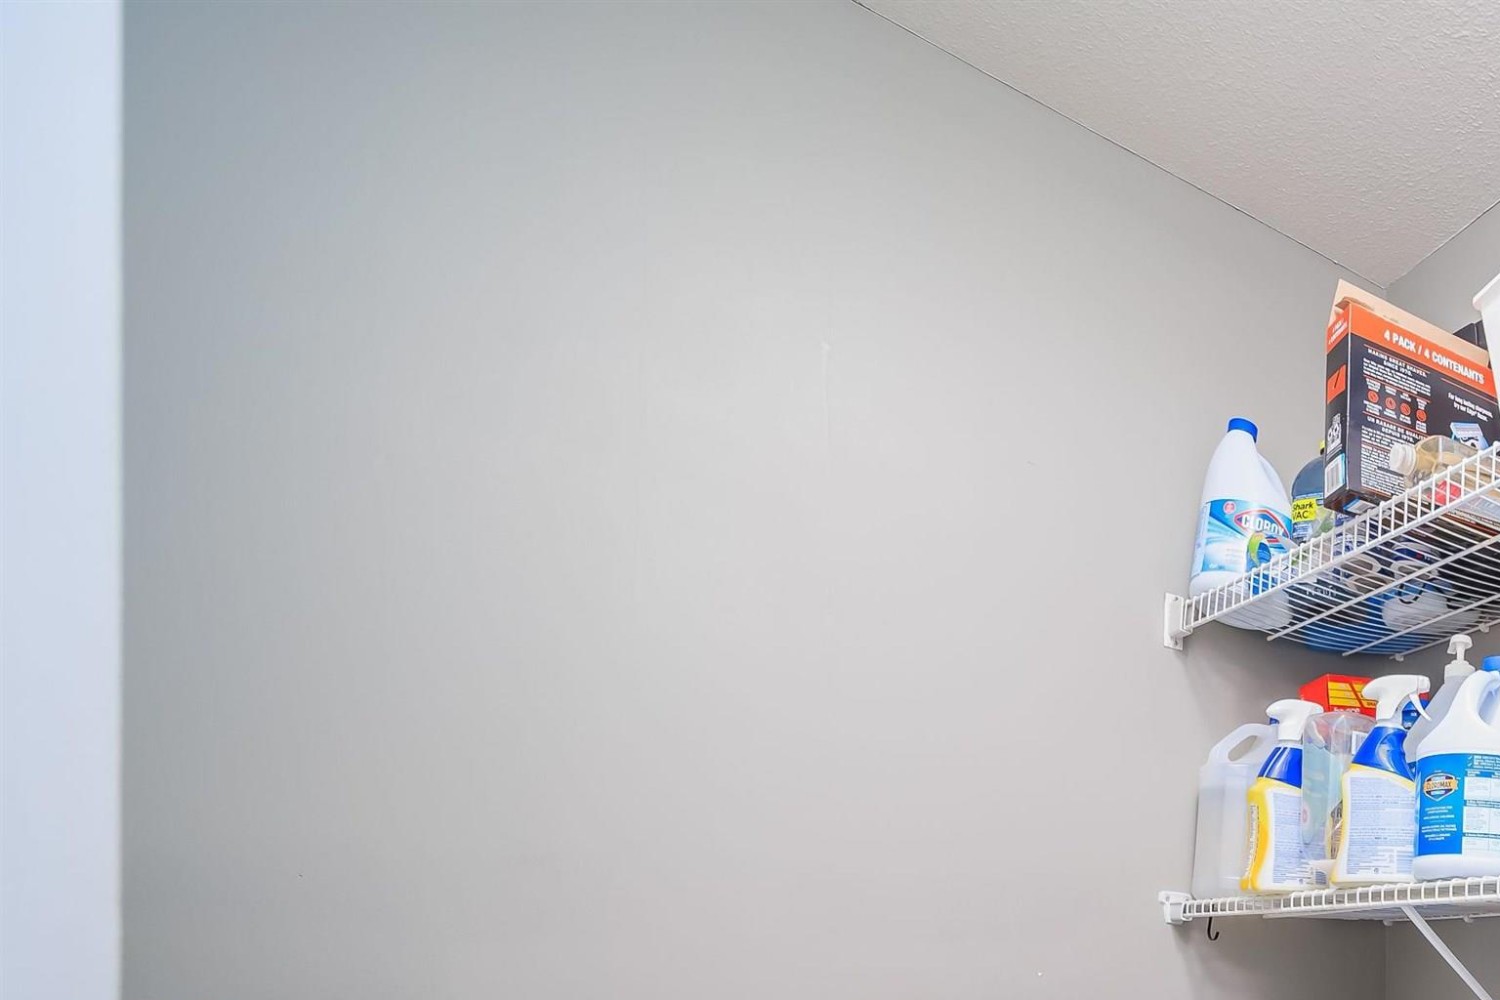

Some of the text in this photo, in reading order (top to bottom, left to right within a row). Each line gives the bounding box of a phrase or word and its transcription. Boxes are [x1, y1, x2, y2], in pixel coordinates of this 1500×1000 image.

[1384, 329, 1391, 341] 4
[1392, 332, 1416, 353] PACK
[1431, 351, 1485, 384] CONTENANTS
